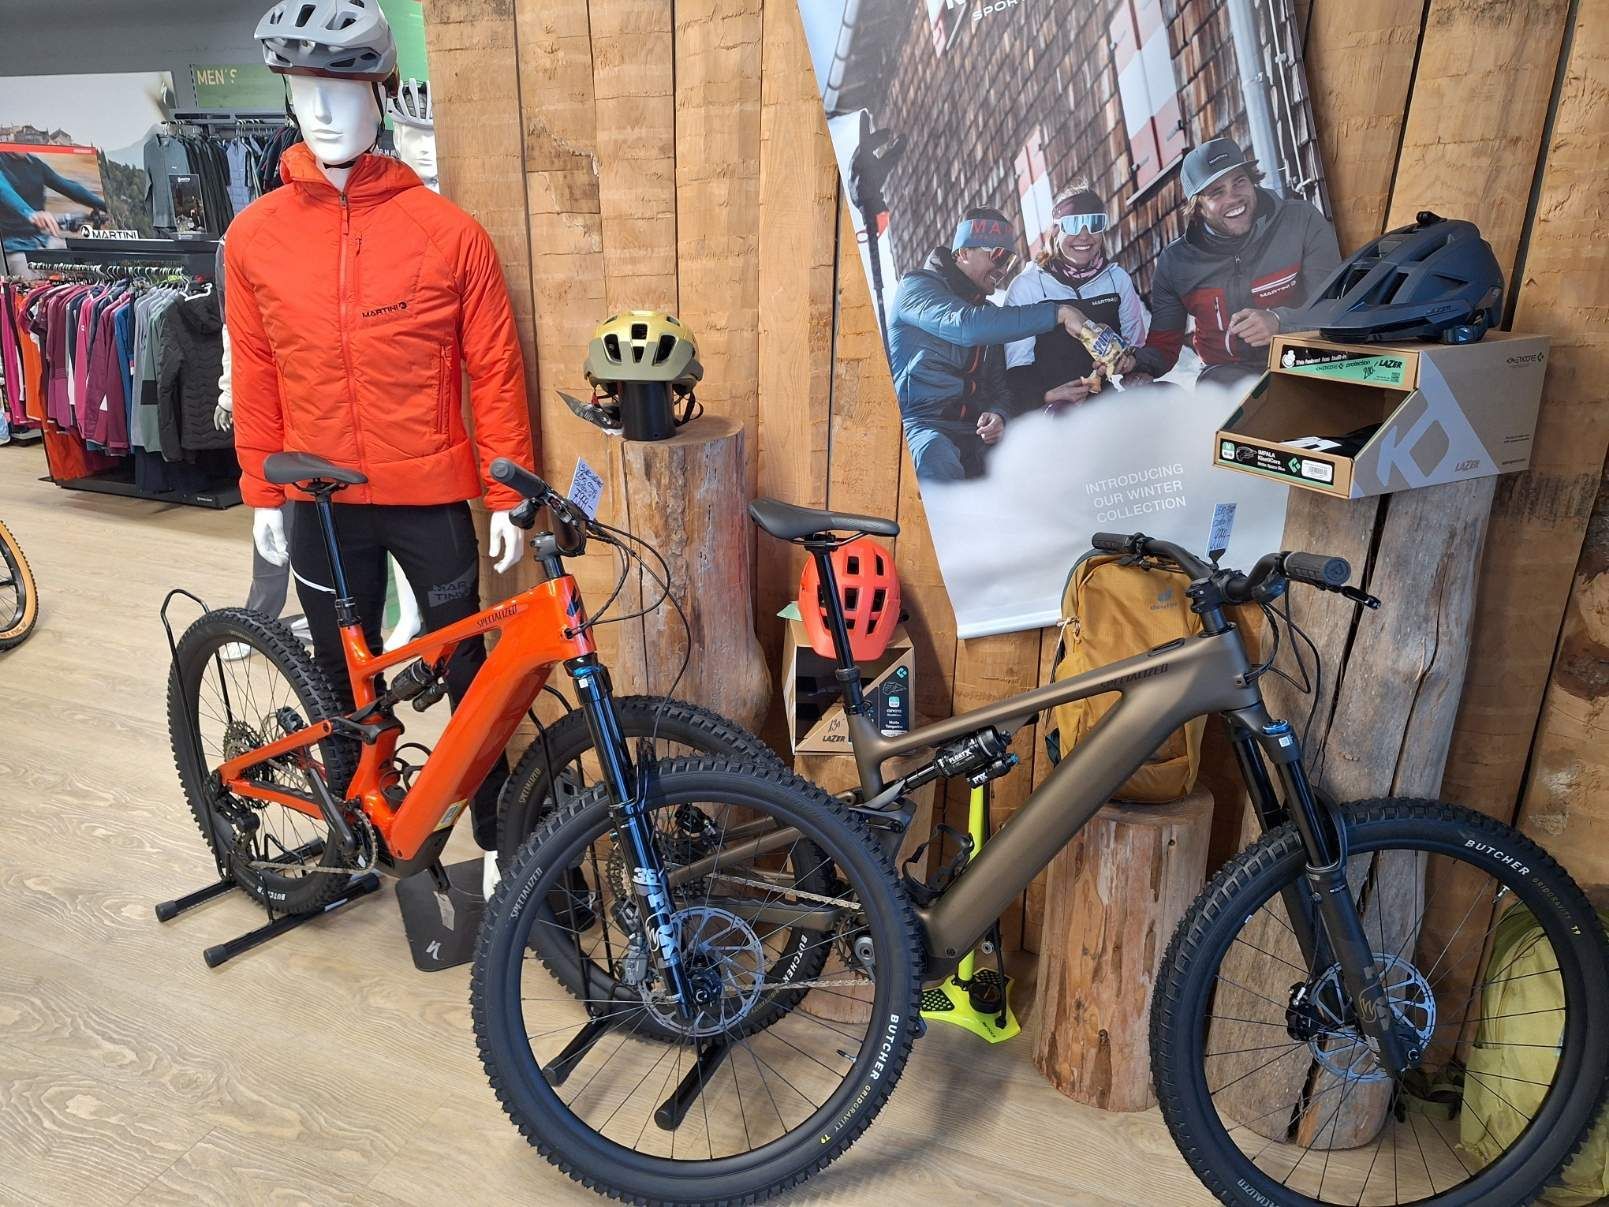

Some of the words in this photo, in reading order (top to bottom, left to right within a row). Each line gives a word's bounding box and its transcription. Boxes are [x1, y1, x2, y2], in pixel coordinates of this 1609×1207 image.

[92, 231, 137, 239] MARTINI
[361, 304, 399, 318] MARTINI
[1380, 359, 1403, 369] LAZER
[1455, 459, 1480, 472] LAZER
[1085, 463, 1184, 495] INTRODUCING
[1094, 492, 1124, 508] OUR
[1127, 480, 1183, 500] WINTER
[1096, 496, 1187, 523] COLLECTION
[476, 604, 519, 628] SPECIALIZED
[1101, 663, 1169, 689] SPECIALIZED
[823, 735, 845, 743] LAZER
[973, 772, 988, 784] FOX
[1465, 839, 1530, 876] BUTCHER
[510, 867, 544, 919] SPECIALIZED
[782, 934, 808, 984] BUTCHER
[870, 1013, 900, 1081] BUTCHER
